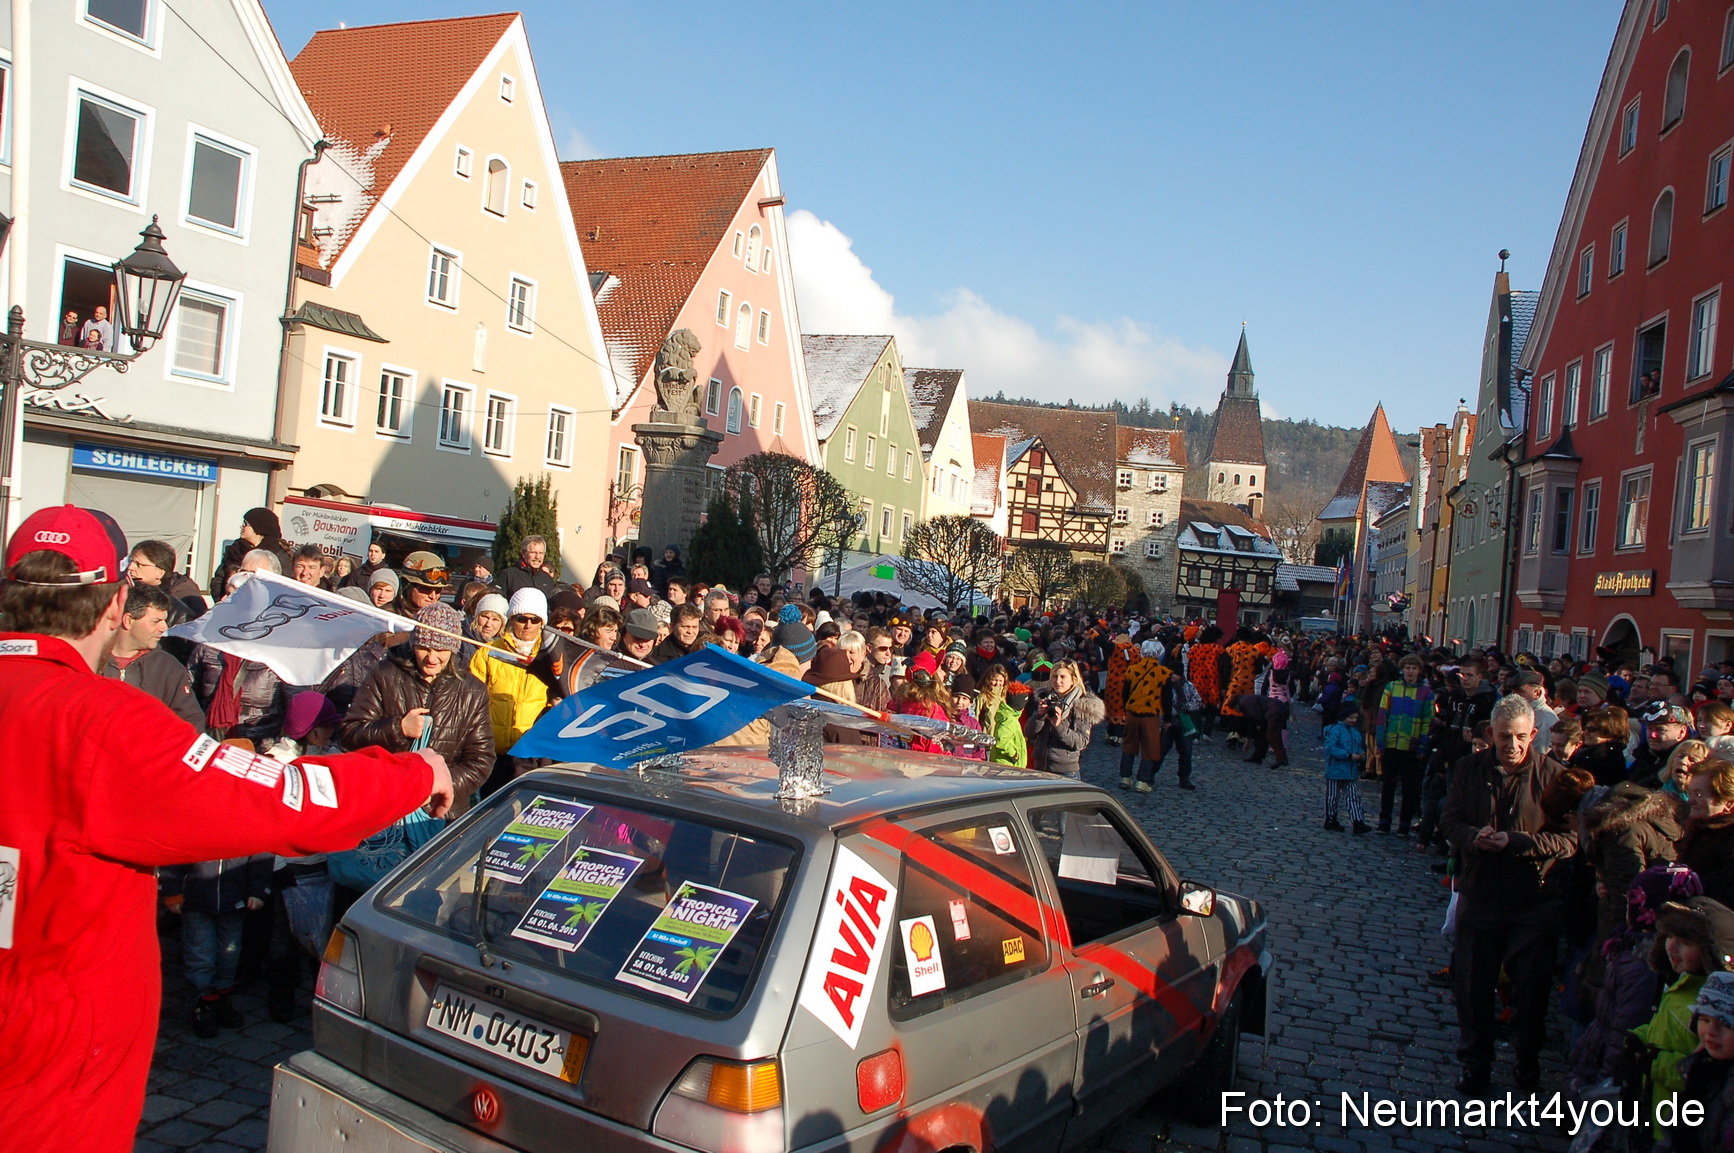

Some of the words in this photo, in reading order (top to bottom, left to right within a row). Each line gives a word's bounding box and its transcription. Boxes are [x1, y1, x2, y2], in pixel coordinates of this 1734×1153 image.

[91, 448, 210, 477] SCHLECKER
[390, 519, 403, 528] Der
[404, 521, 450, 534] Mühlenbäcker
[522, 814, 574, 830] NIGHT
[530, 808, 577, 820] TROPICAL
[565, 868, 623, 887] NIGHT
[573, 861, 626, 876] TROPICAL
[679, 898, 739, 918] TROPICAL
[671, 906, 737, 930] NIGHT
[823, 875, 887, 1030] AVIA
[1003, 939, 1023, 957] ADAC
[632, 959, 644, 969] SA
[914, 962, 939, 977] Shell
[438, 993, 476, 1036] NM
[485, 1011, 556, 1065] 0403
